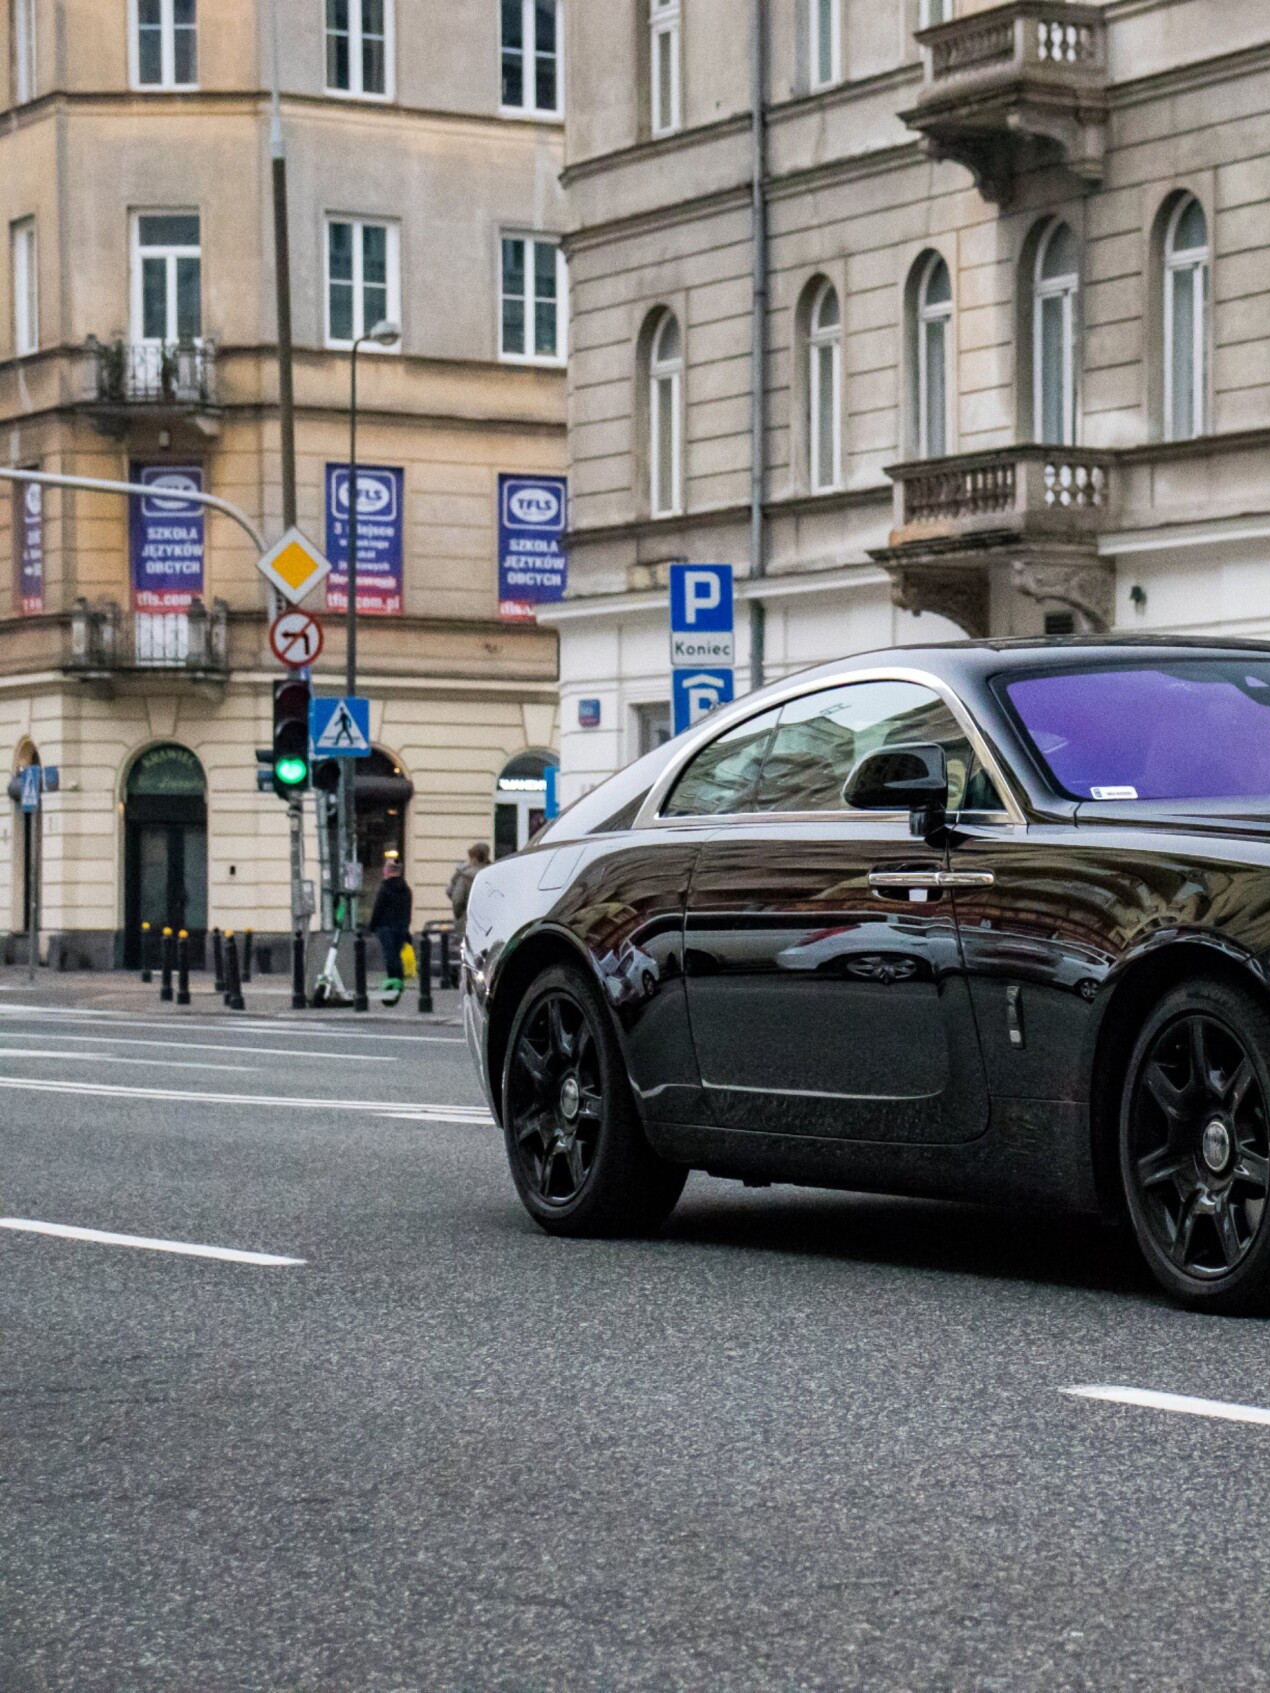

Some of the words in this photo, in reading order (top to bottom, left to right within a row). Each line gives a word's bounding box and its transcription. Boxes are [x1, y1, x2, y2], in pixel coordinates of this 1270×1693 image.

[517, 498, 552, 511] TFLS
[145, 561, 201, 575] OBCYCH
[507, 571, 562, 586] OBCYCH
[684, 571, 721, 624] P
[674, 641, 731, 656] Koniec
